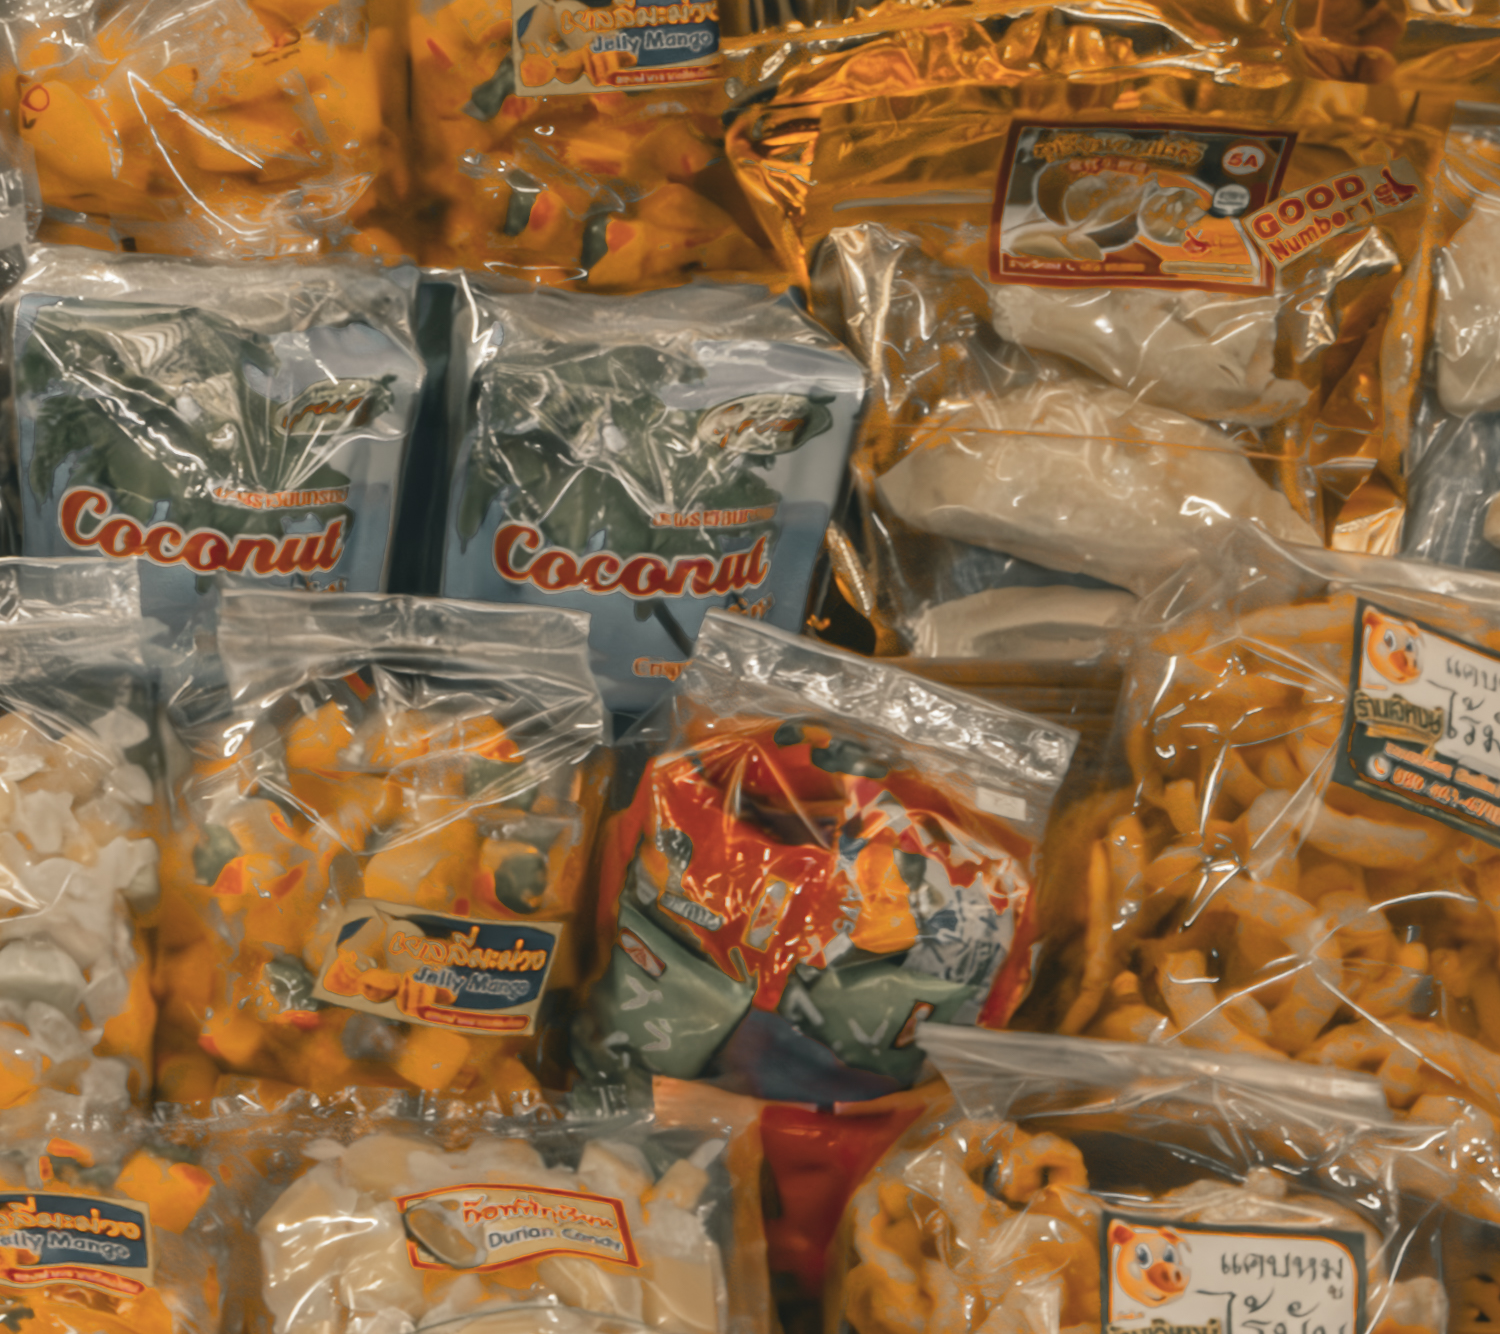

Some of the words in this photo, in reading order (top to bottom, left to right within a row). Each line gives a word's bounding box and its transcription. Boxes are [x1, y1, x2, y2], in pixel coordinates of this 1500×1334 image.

[591, 31, 638, 55] Jelly
[645, 29, 714, 55] Mango
[1253, 173, 1366, 243] GOOD
[1266, 211, 1358, 267] Number
[60, 485, 346, 575] Coconut
[492, 523, 772, 599] Coconut
[414, 963, 462, 989] Jelly
[466, 973, 530, 999] Mango
[47, 1231, 130, 1261] Mango
[488, 1225, 552, 1251] Durian
